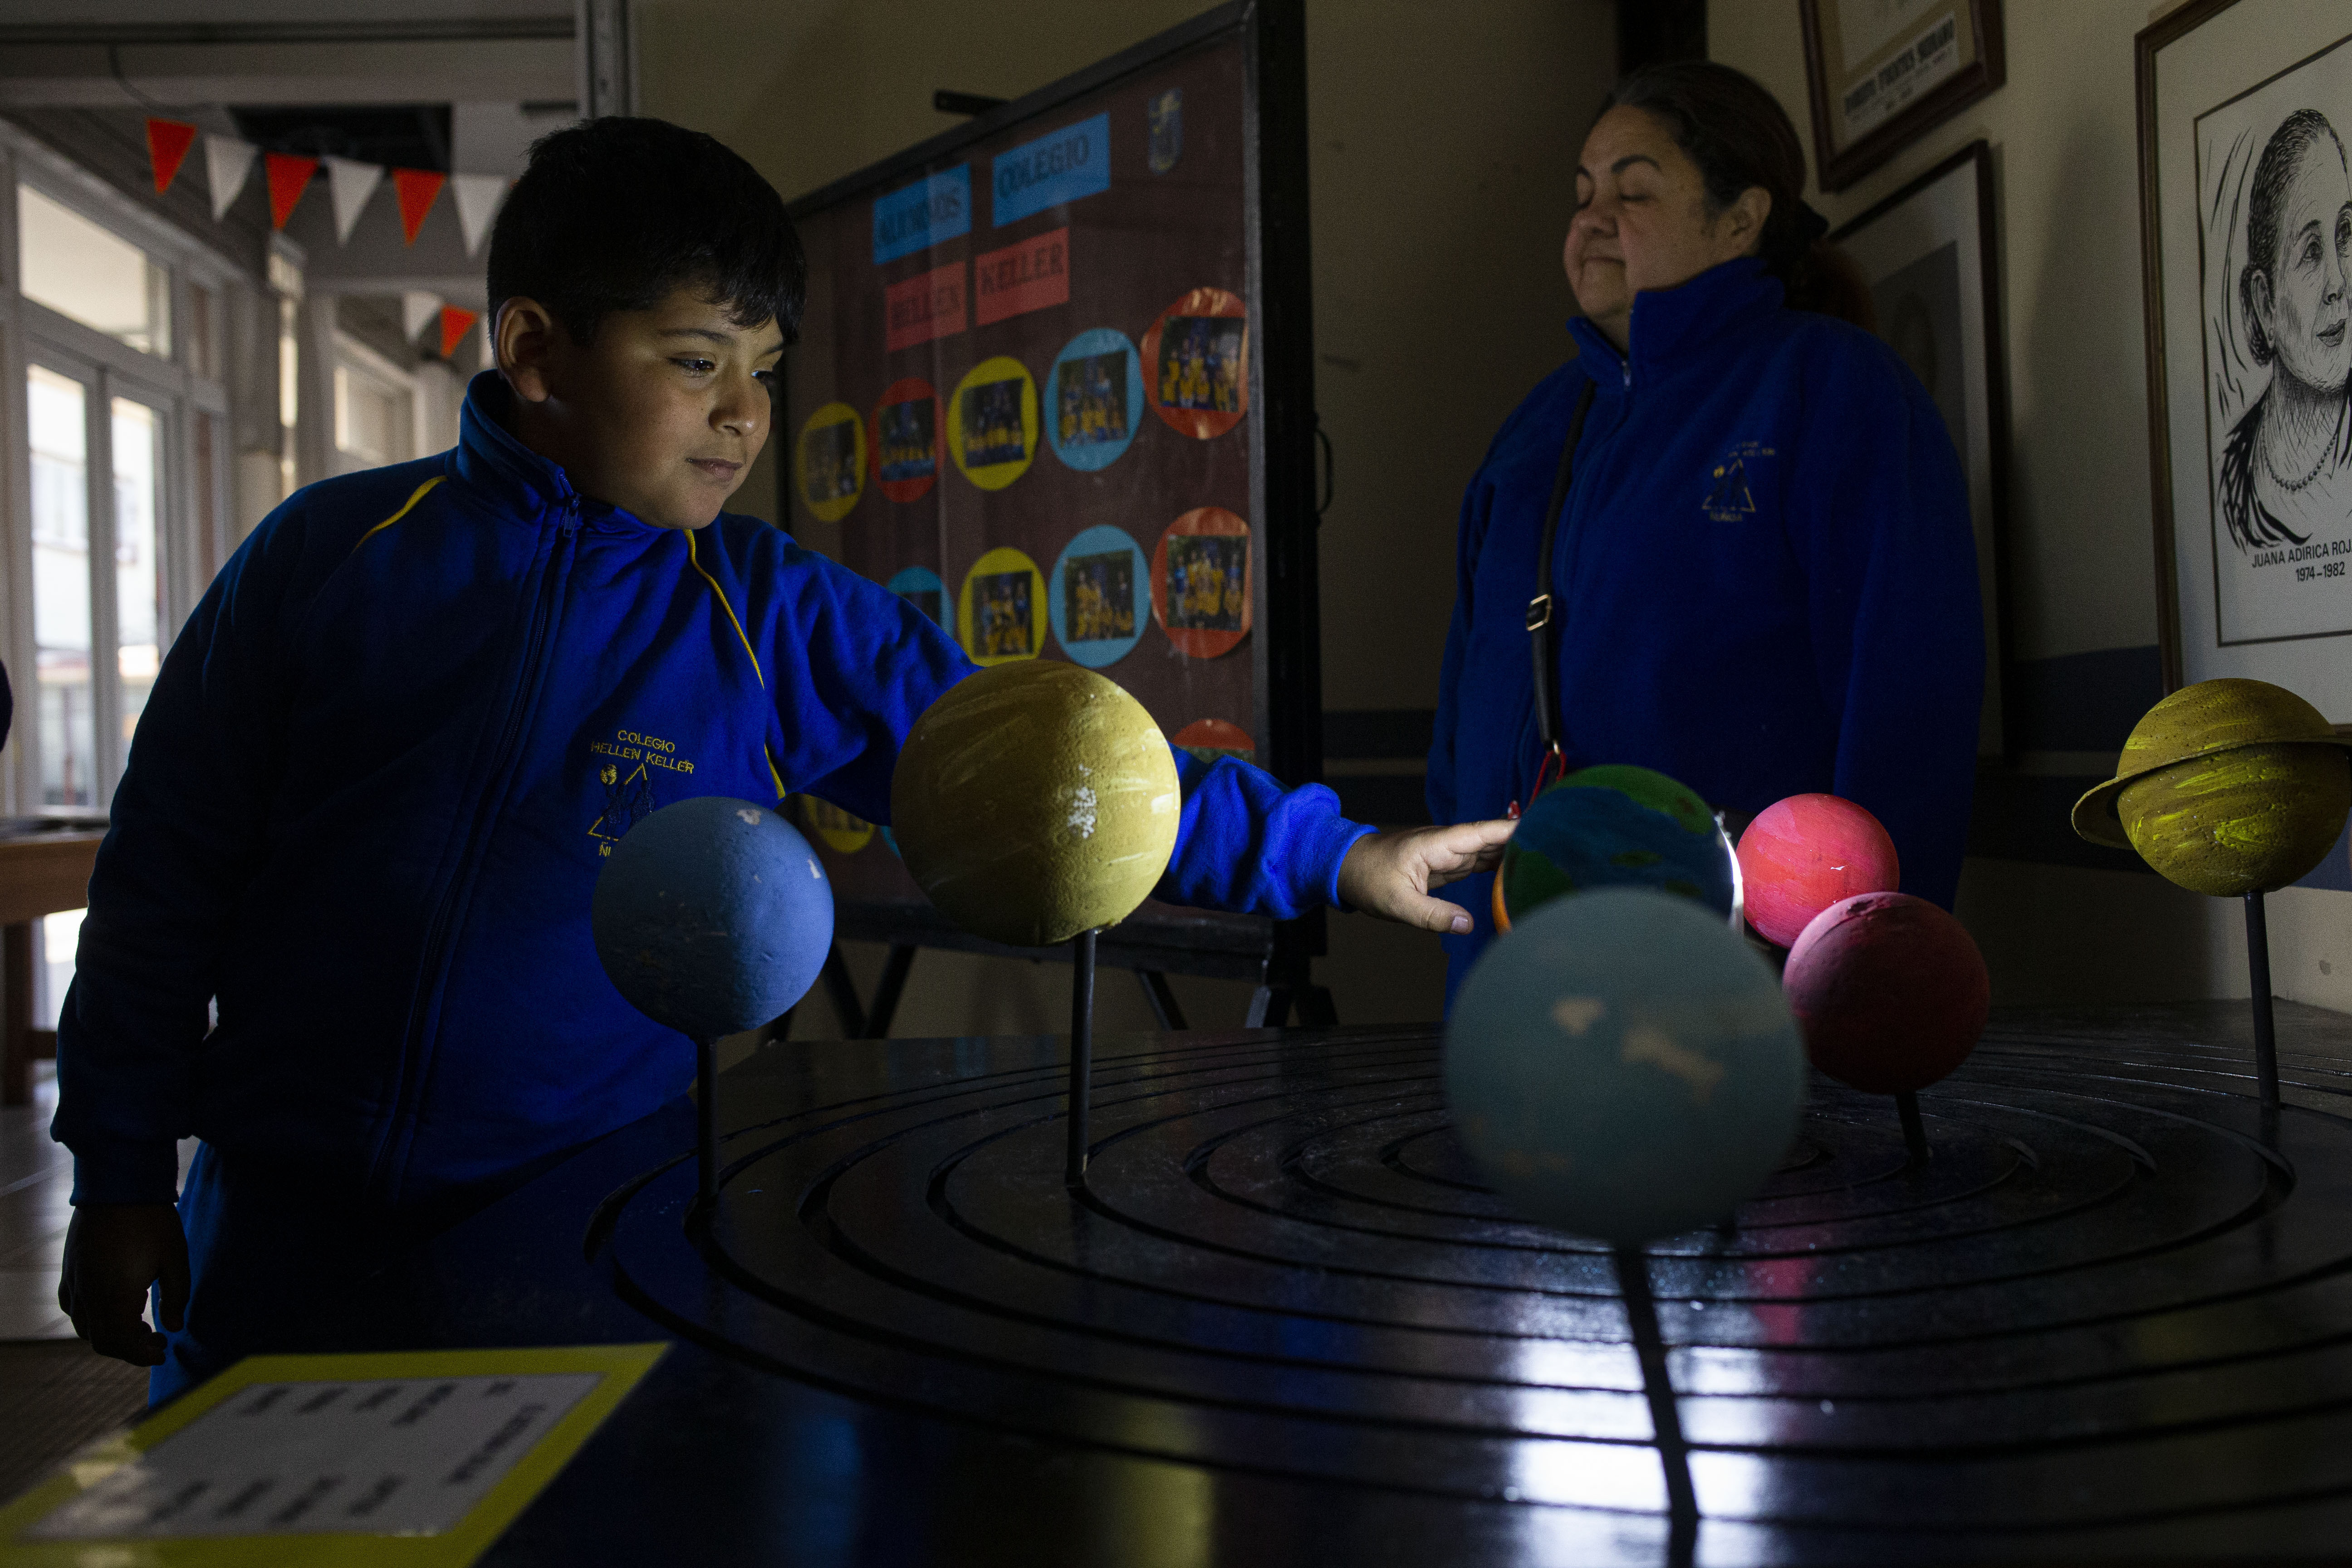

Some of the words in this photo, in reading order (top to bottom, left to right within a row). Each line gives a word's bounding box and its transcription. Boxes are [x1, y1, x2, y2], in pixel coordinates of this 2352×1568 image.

[981, 241, 1064, 295] KELLER
[2252, 550, 2285, 568] JUANA
[2288, 544, 2329, 563] ADIRICA
[2332, 539, 2352, 556] ROJ
[2296, 561, 2345, 582] 1974-1982
[617, 730, 675, 753] COLEGIO
[590, 741, 641, 760] HELLEN
[646, 751, 695, 774] KELLER
